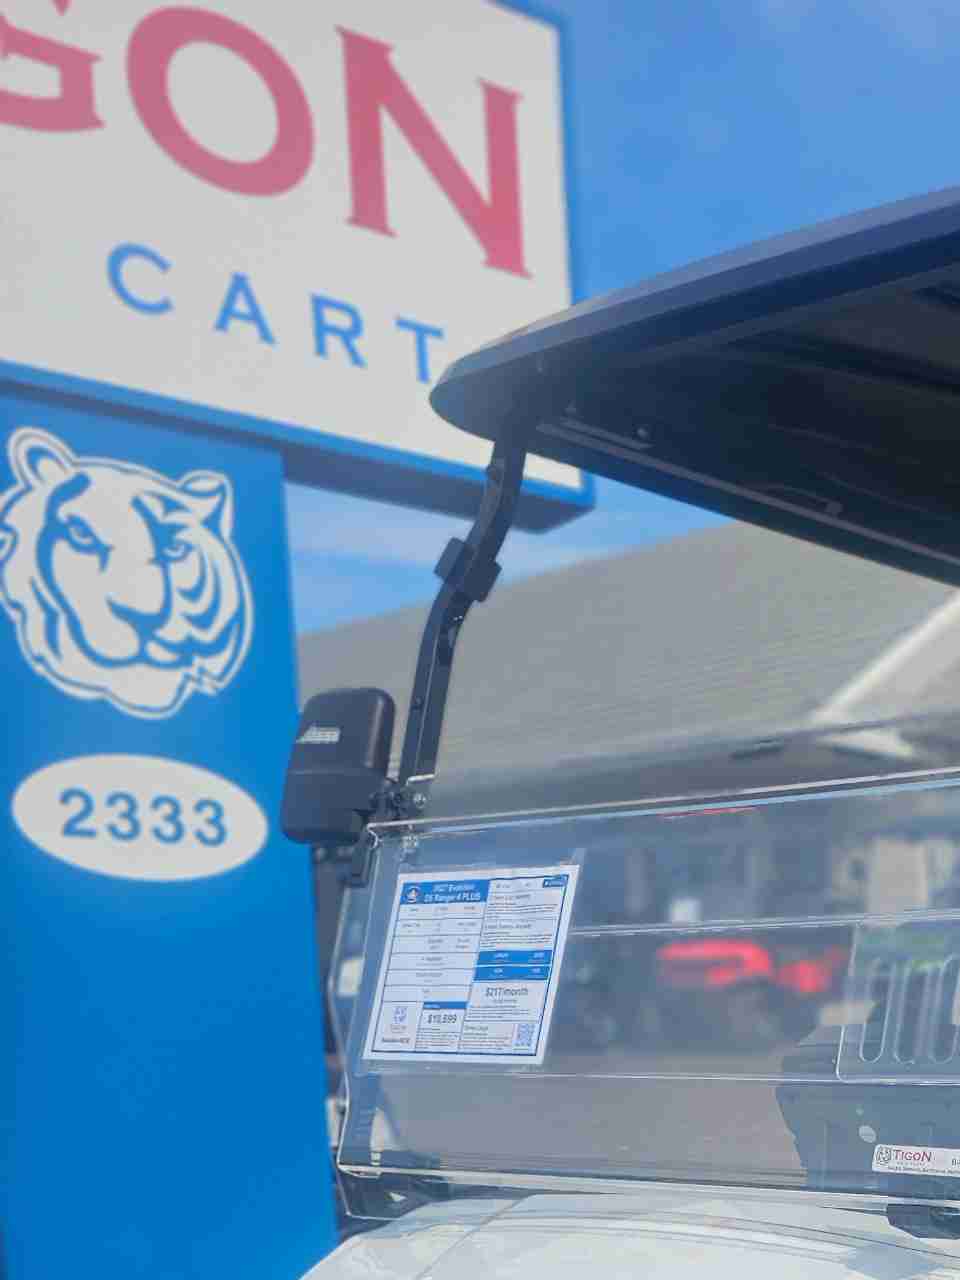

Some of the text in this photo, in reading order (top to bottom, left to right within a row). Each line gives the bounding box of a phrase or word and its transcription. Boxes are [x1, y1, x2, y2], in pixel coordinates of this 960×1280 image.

[106, 242, 445, 384] CART
[58, 788, 228, 847] 2333
[893, 1149, 933, 1162] TIGON
